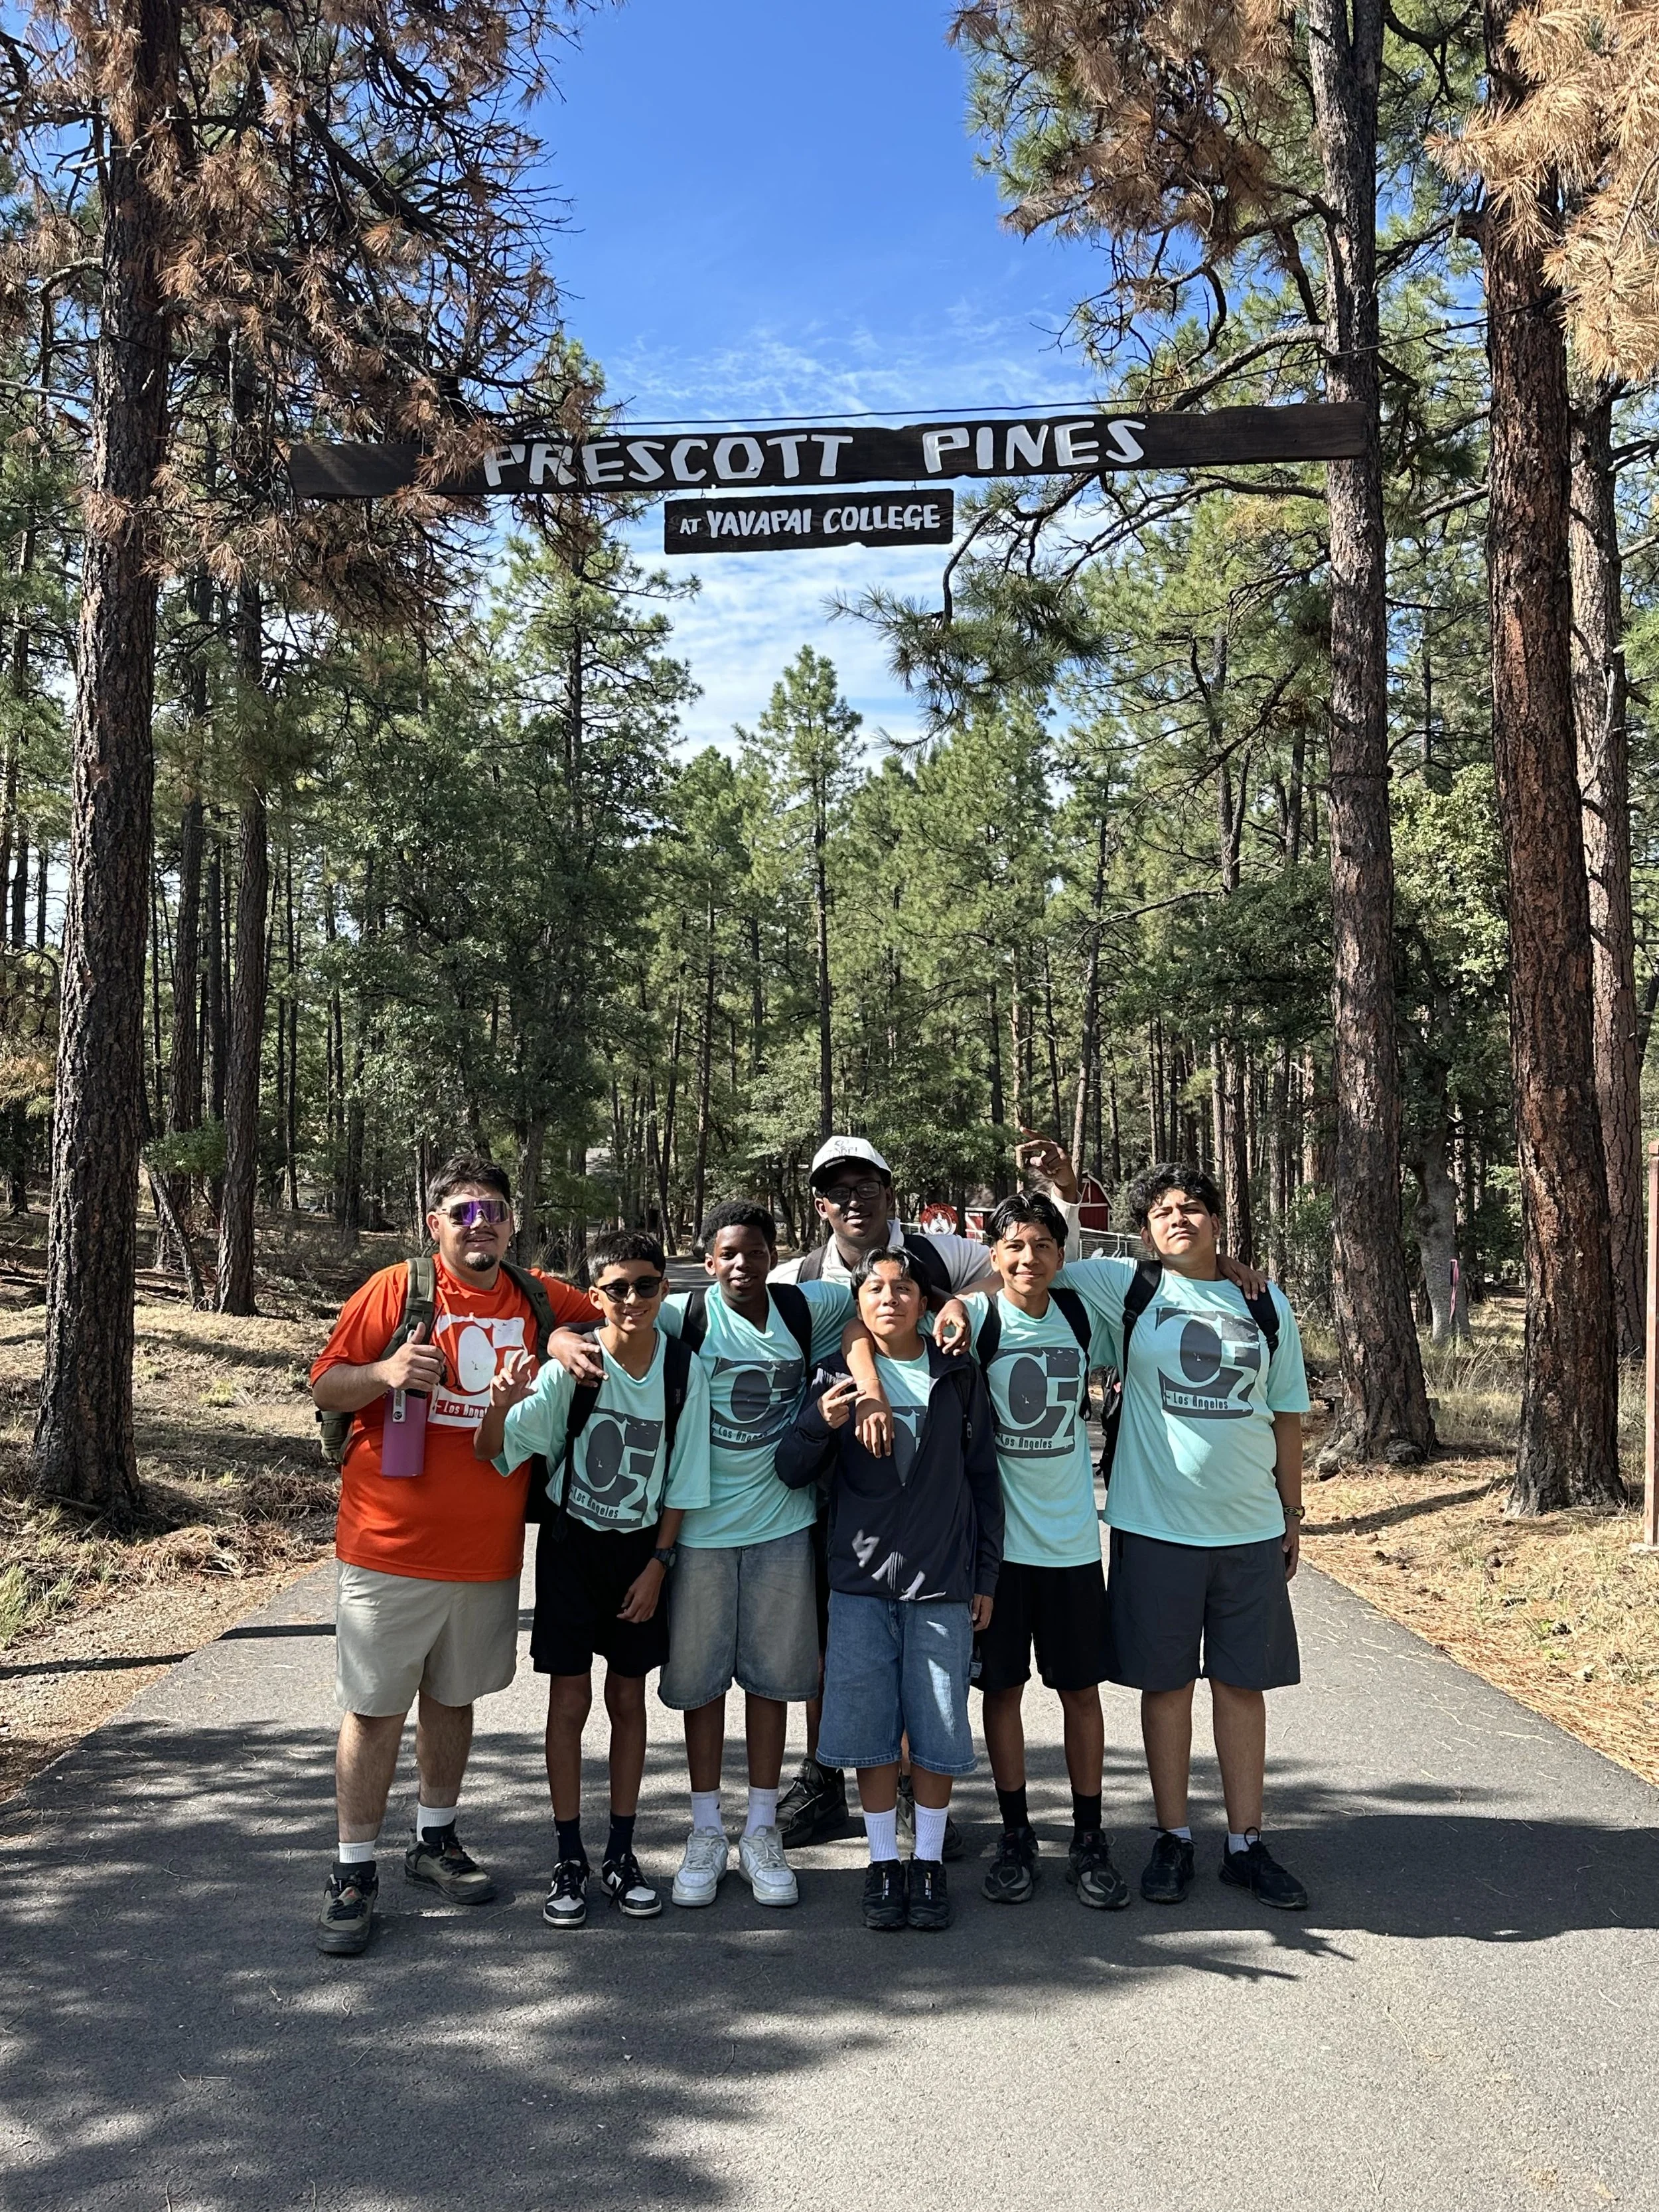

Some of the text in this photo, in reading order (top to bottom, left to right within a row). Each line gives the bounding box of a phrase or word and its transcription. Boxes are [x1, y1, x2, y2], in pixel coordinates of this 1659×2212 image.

[483, 419, 1146, 487] PRESCOTT PINES
[680, 504, 940, 538] AT YAVAPAI COLLEGE
[443, 1400, 460, 1414] Los
[1173, 1392, 1228, 1410] Los Angeles
[1001, 1434, 1052, 1449] Los Angeles
[587, 1497, 618, 1518] Angeles
